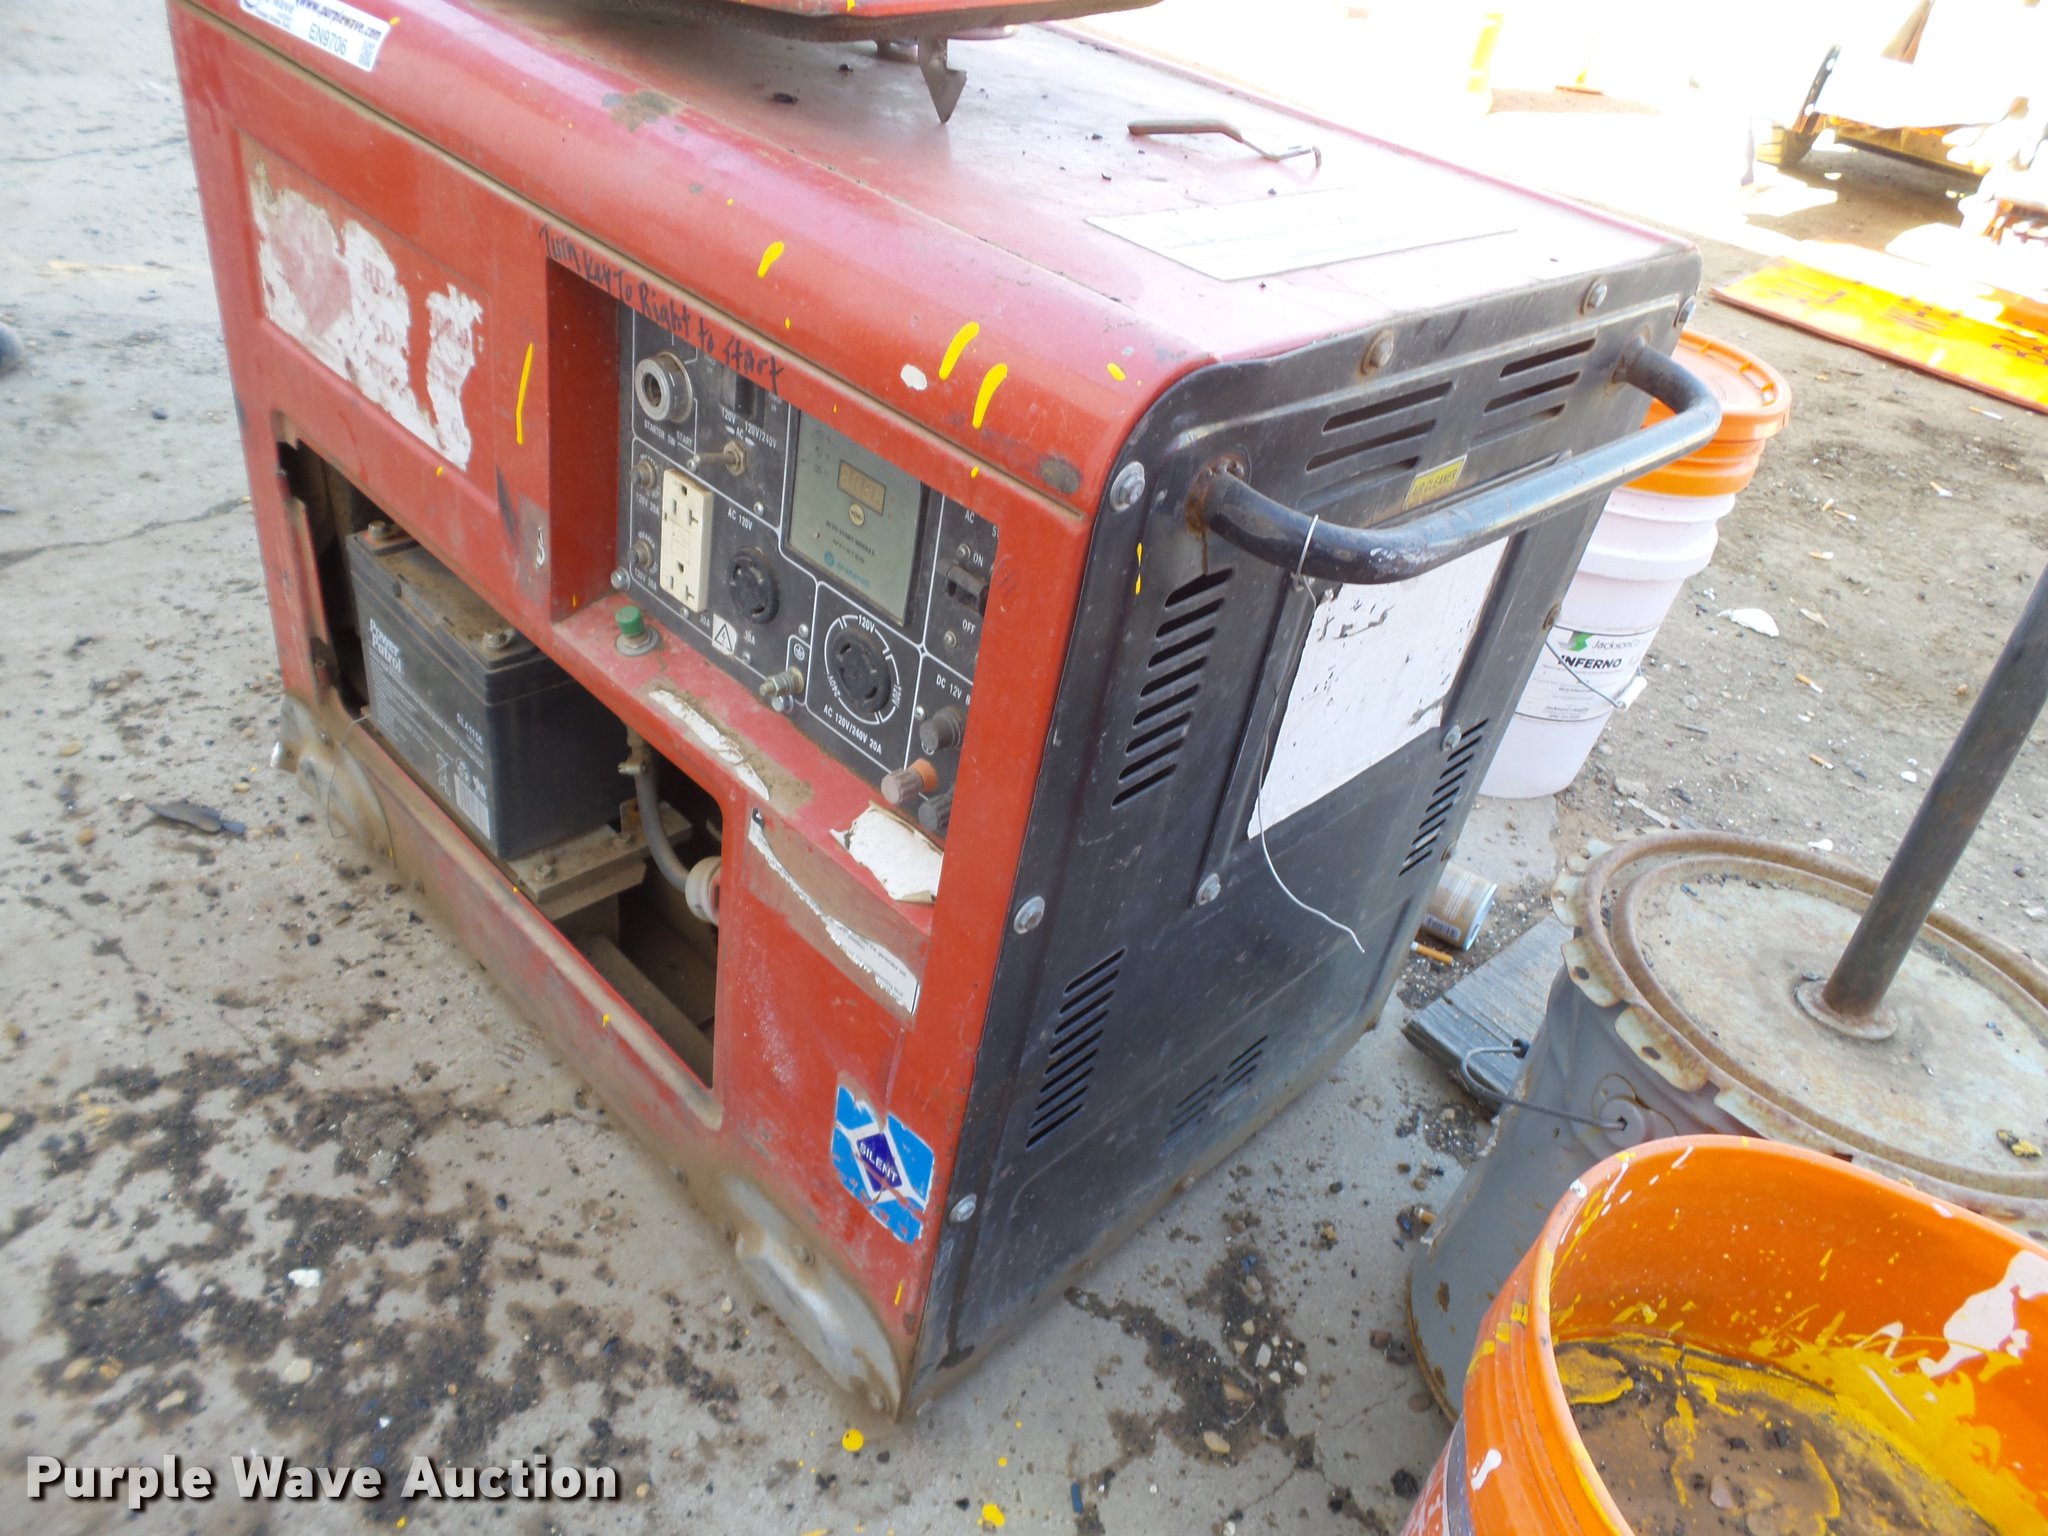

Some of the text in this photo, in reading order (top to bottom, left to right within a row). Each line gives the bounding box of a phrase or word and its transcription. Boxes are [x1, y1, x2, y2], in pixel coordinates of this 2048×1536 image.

[308, 23, 348, 56] EN9706
[727, 507, 753, 531] AC 120V
[964, 508, 976, 524] AC
[972, 552, 985, 567] ON
[858, 614, 876, 634] 120V
[962, 618, 976, 635] OFF
[936, 673, 946, 689] DC
[950, 683, 963, 700] 12V
[823, 703, 882, 756] AC 120V/240V 20A
[858, 1142, 898, 1184] SILENT
